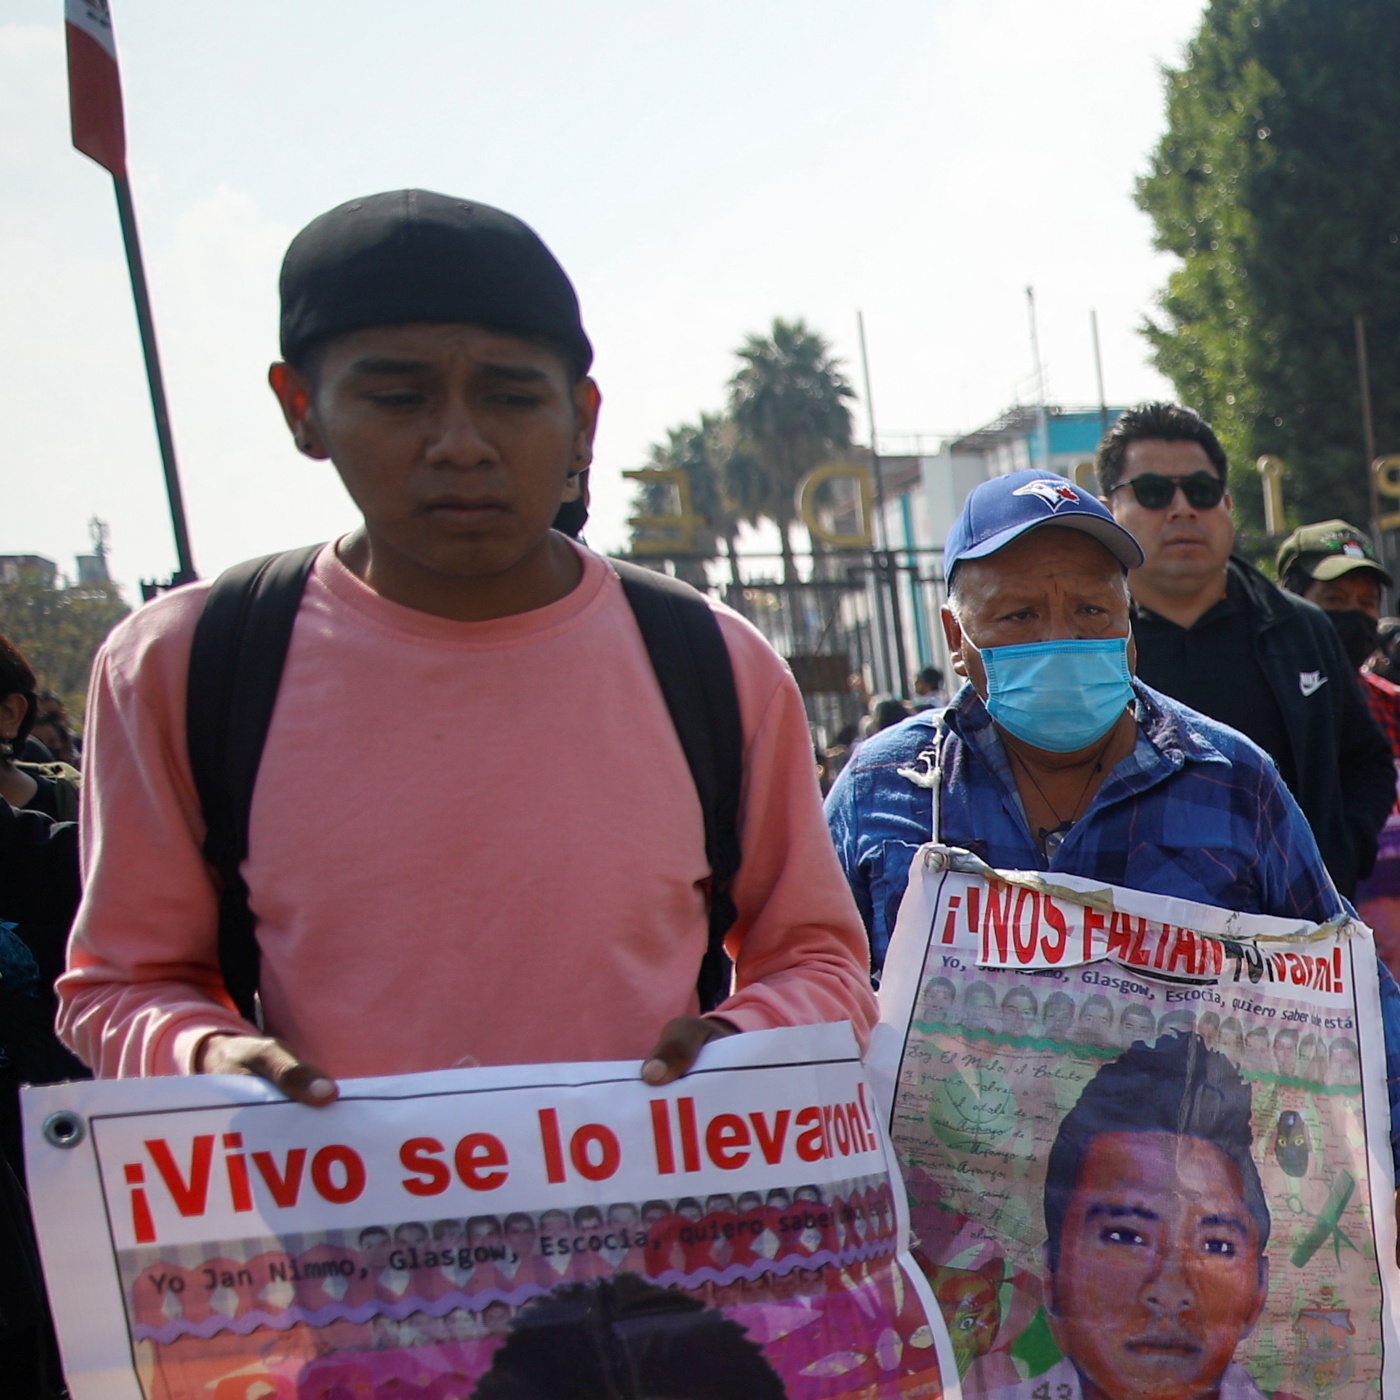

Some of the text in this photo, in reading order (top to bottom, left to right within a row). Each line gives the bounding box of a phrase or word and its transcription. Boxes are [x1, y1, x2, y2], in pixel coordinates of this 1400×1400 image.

[982, 880, 1067, 964] NOS
[1083, 905, 1223, 975] FALTAN
[942, 956, 966, 972] Yo,
[1081, 971, 1156, 1000] Glasgow,
[1165, 989, 1225, 1008] Escocia,
[1232, 999, 1276, 1018] quiero
[1281, 1008, 1308, 1023] saber
[1324, 1015, 1353, 1030] está
[124, 1082, 877, 1244] ¡Vivo se lo llevaron!
[148, 1273, 185, 1295] Yo
[204, 1267, 253, 1290] Jan
[268, 1258, 368, 1283] Nimmo,
[389, 1244, 519, 1271] Glasgow,
[540, 1226, 662, 1257] Escocia,
[679, 1219, 765, 1247] quiero
